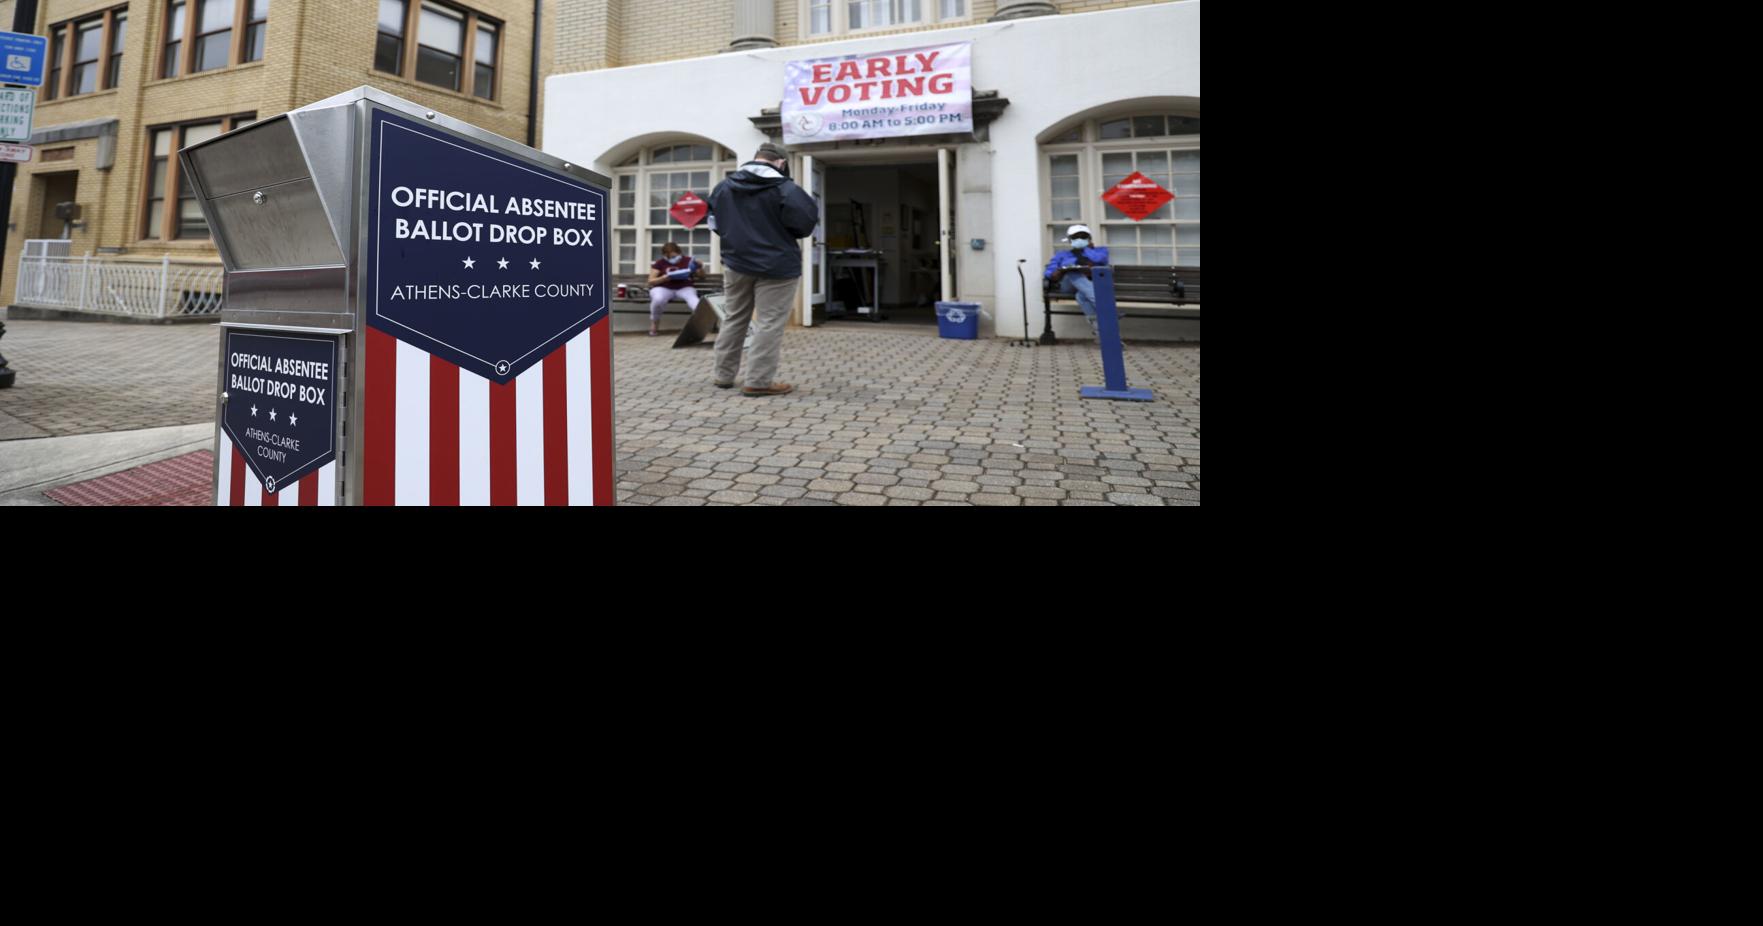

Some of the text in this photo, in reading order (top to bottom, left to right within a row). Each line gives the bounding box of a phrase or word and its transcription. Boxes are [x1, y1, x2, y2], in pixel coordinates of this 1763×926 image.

[812, 51, 940, 83] EARLY
[19, 92, 30, 102] OF
[799, 73, 953, 106] VOTING
[829, 113, 962, 132] 8:00 AM to 5:00 PM
[842, 102, 946, 117] Monday-Friday
[391, 186, 596, 220] OFFICIAL ABSENTEE
[395, 218, 594, 247] BALLOT DROP BOX
[390, 283, 594, 300] ATHENS-CLARKE COUNTY
[231, 352, 329, 380] OFFICIAL ABSENTEE
[231, 374, 326, 406] BALLOT DROP BOX
[245, 427, 300, 451] ATHENS-CLARKE
[257, 445, 287, 463] COUNTY
